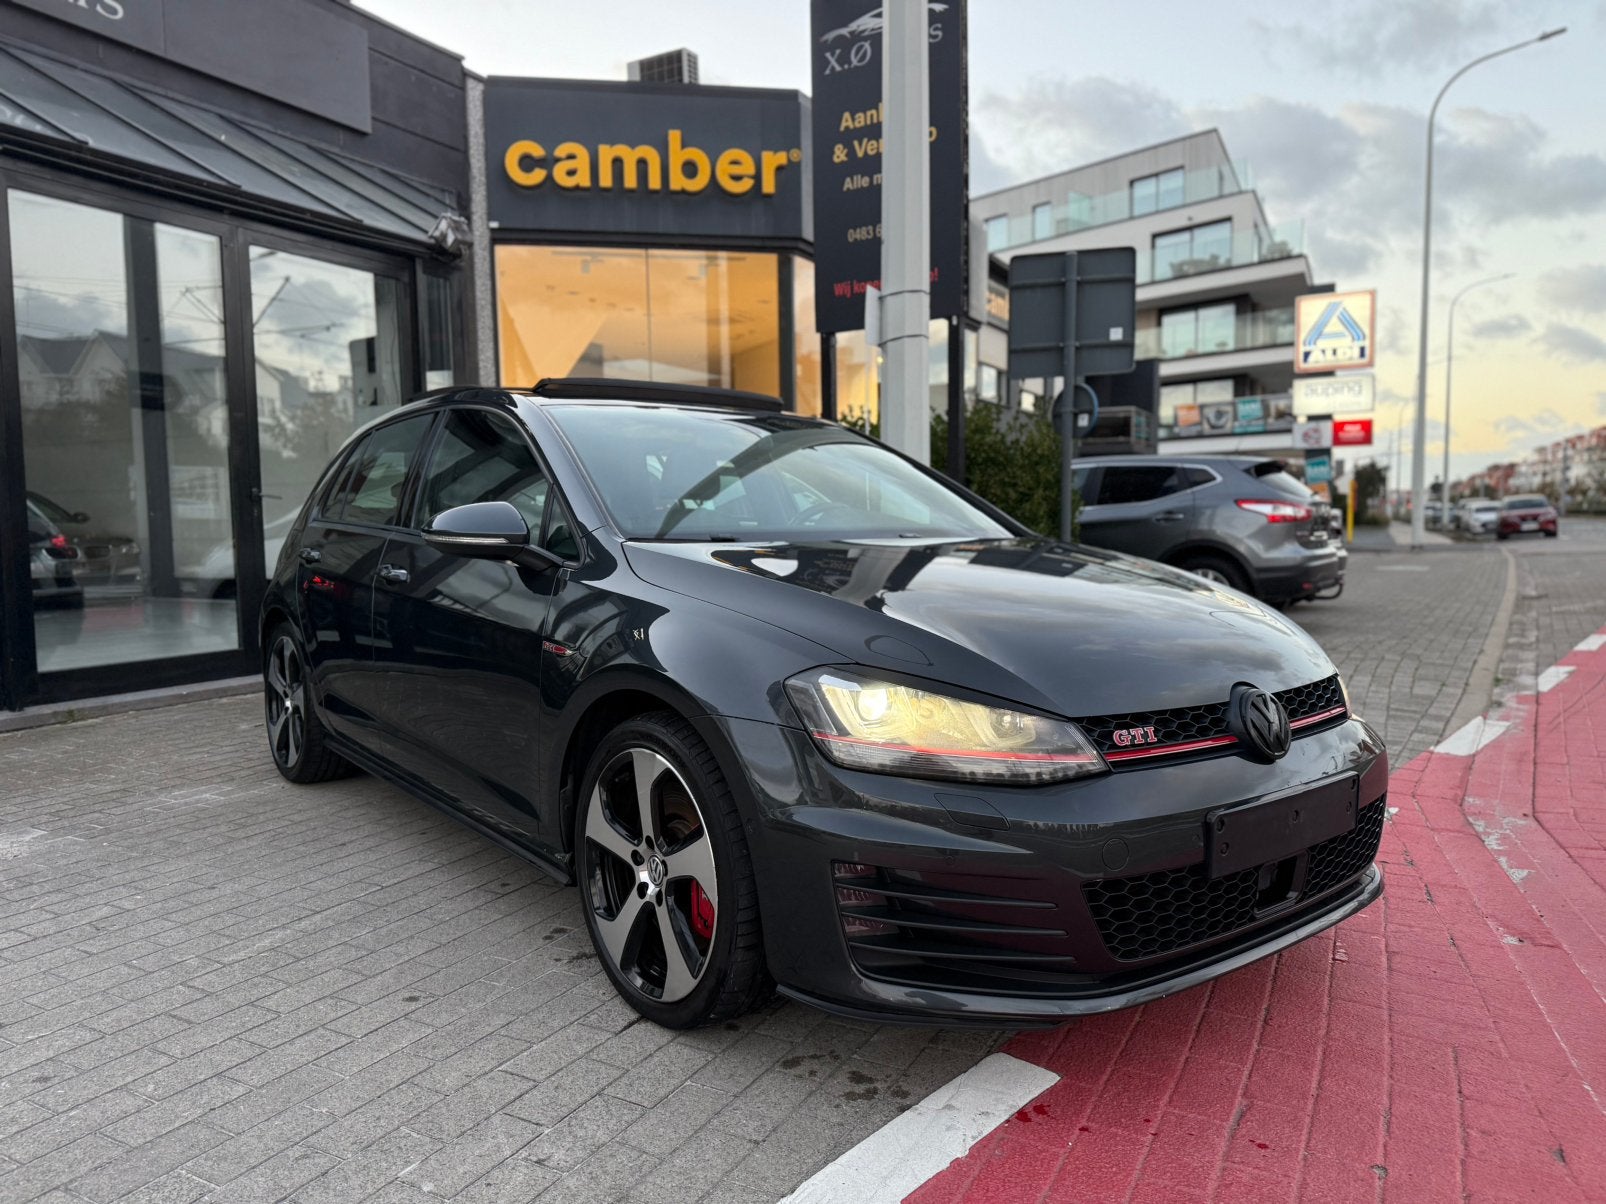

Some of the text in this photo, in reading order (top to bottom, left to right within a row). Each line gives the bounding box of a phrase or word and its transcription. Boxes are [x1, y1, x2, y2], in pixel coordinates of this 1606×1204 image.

[504, 129, 789, 195] camber
[832, 143, 848, 164] &
[842, 174, 870, 192] Alle
[1113, 726, 1157, 746] GTI
